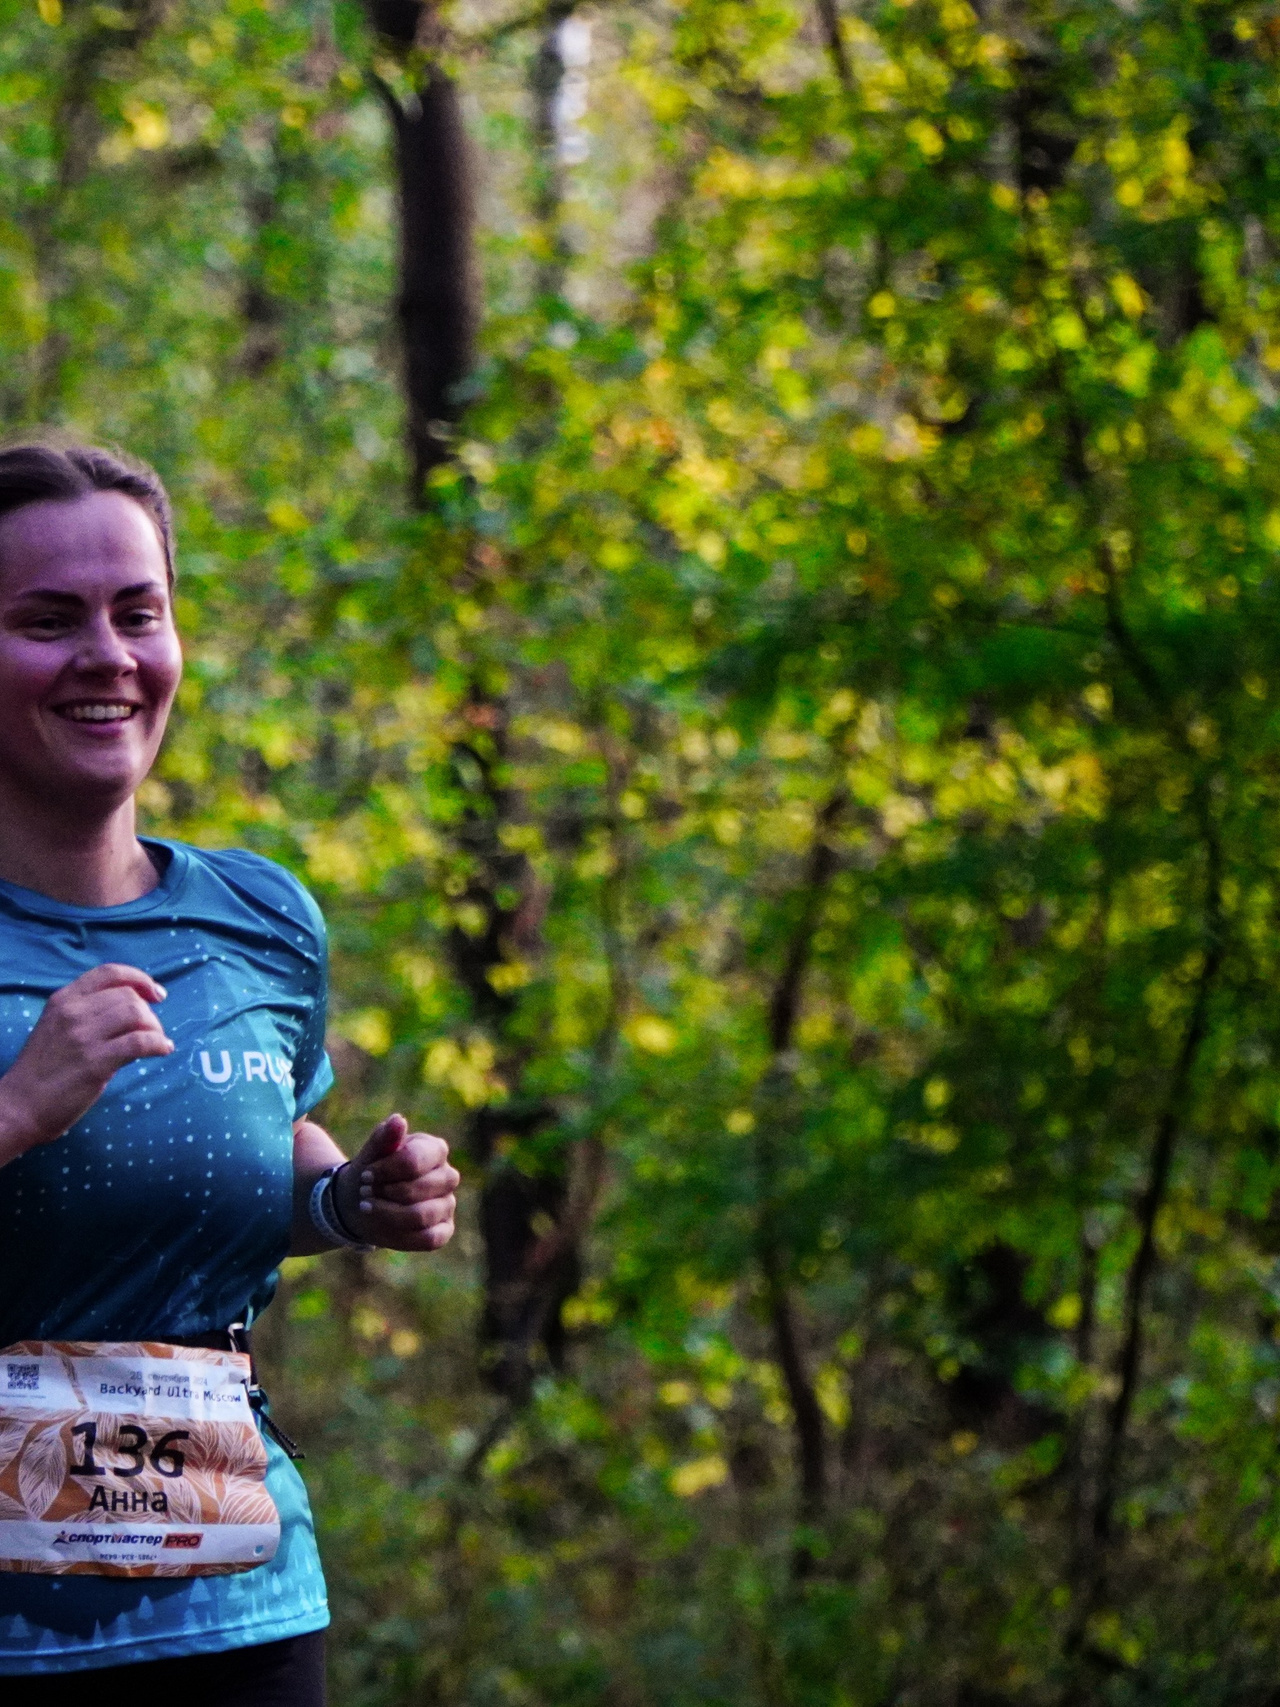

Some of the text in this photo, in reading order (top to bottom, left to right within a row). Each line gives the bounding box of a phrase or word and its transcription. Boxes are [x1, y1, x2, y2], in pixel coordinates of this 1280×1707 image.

[200, 1050, 232, 1083] U
[100, 1383, 242, 1403] Backyard Ultra Moscow
[70, 1421, 190, 1478] 136
[88, 1485, 169, 1513] Анна
[164, 1534, 201, 1548] PRO
